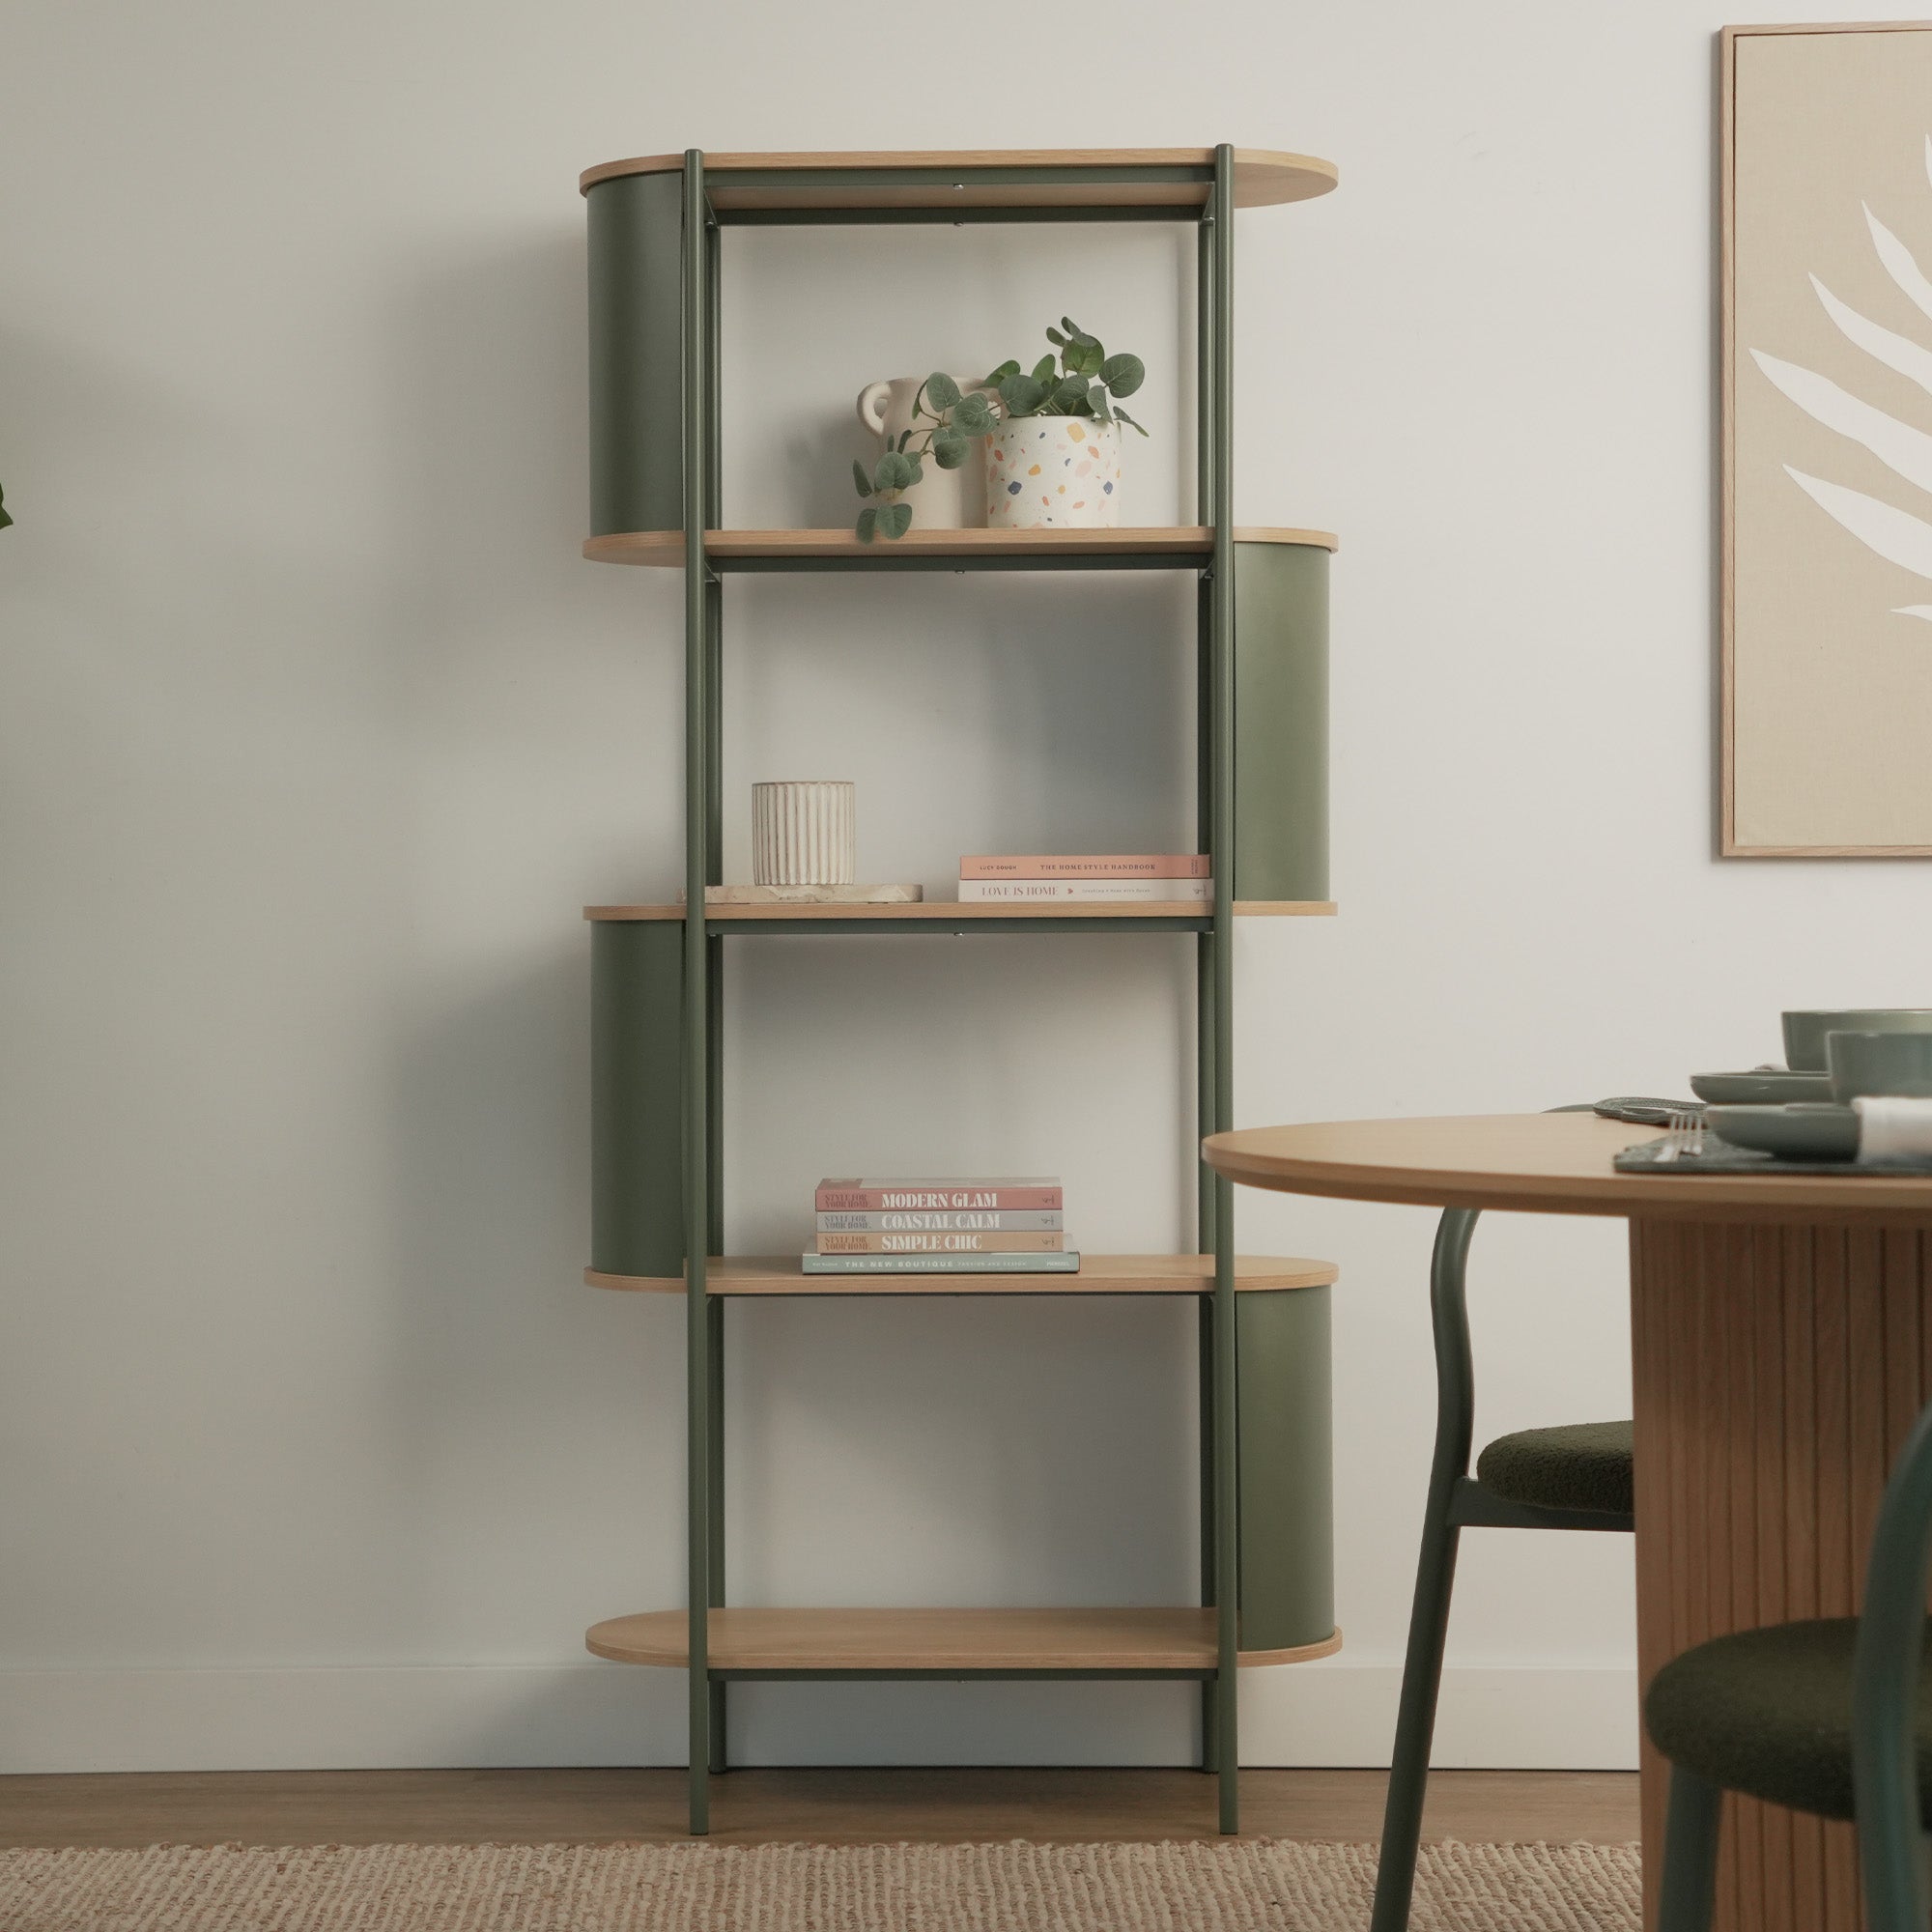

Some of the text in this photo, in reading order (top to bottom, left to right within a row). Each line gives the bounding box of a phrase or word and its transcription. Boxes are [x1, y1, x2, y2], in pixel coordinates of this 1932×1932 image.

[1027, 887, 1059, 895] HOME
[881, 1192, 998, 1208] MODERN GLAM
[881, 1213, 1001, 1230] COASTAL CALM
[881, 1235, 982, 1250] SIMPLE CHIC
